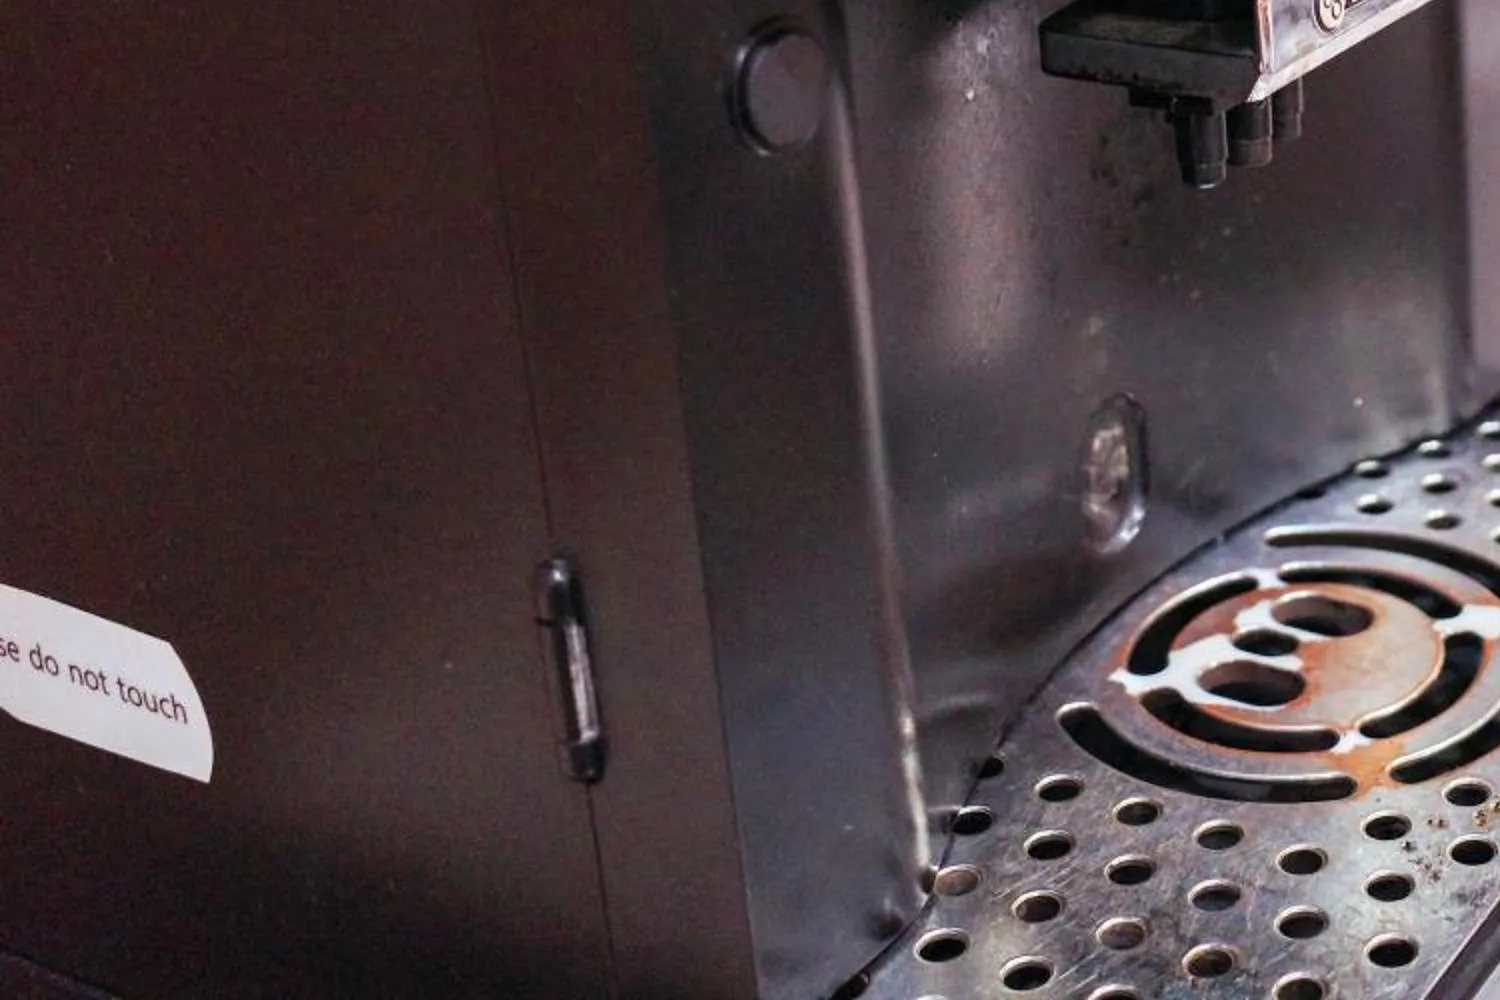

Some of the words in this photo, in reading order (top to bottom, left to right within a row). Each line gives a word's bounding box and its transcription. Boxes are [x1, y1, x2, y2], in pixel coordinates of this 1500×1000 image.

[28, 641, 60, 677] do
[67, 662, 111, 696] not
[116, 676, 188, 725] touch
